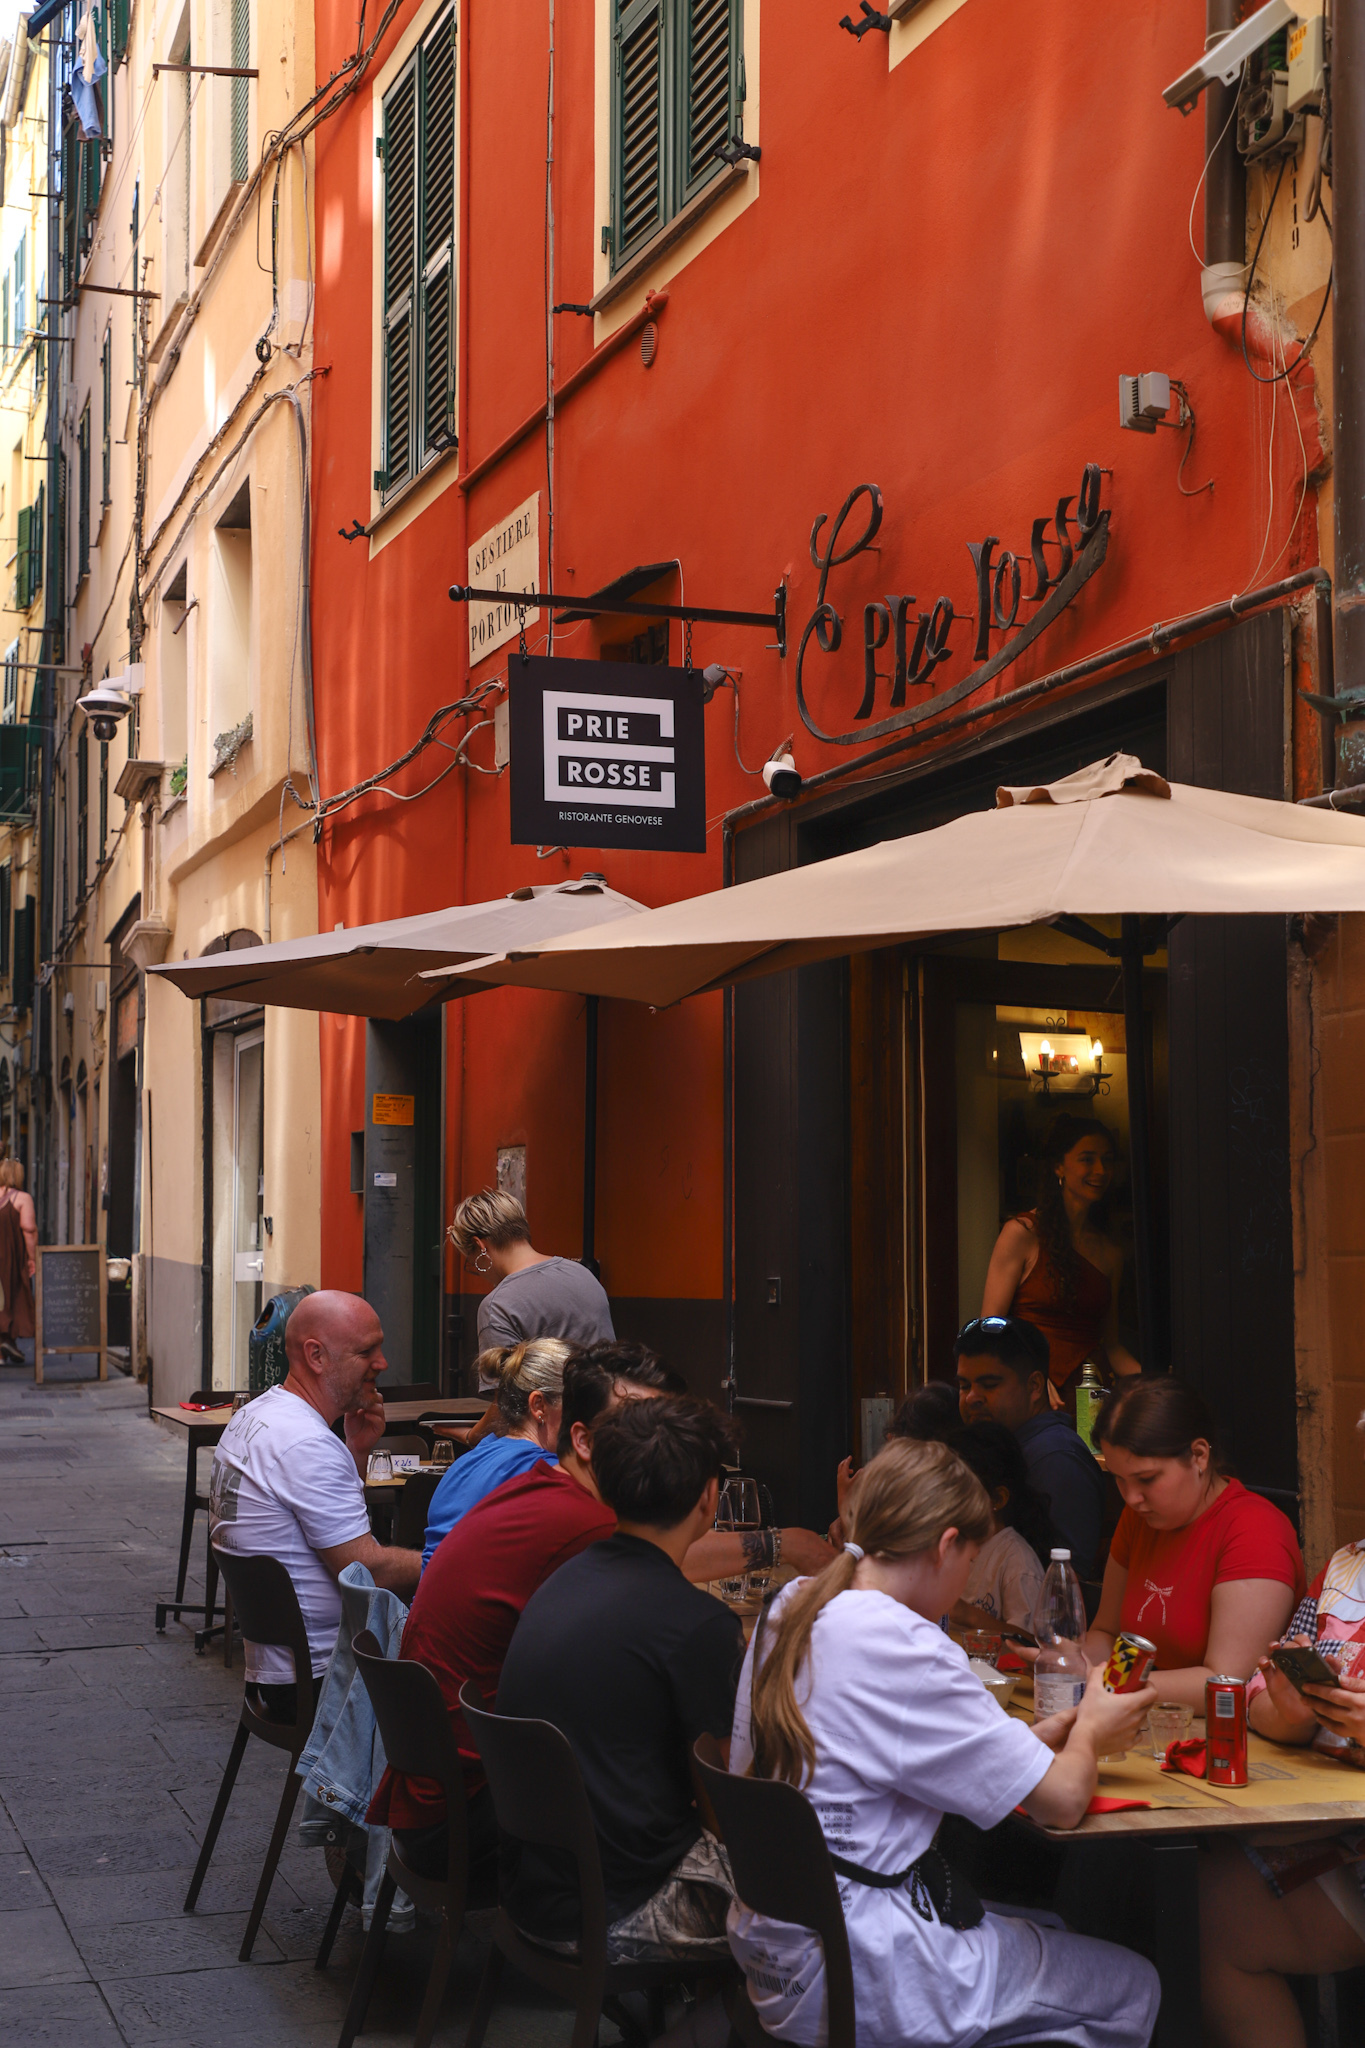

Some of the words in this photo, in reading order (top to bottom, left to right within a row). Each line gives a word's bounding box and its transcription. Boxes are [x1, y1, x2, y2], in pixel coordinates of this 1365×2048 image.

[475, 512, 531, 576] SESTIERE
[495, 568, 507, 591] DI
[567, 713, 629, 739] PRIE
[567, 761, 650, 787] ROSSE
[558, 811, 613, 823] RISTORANTE
[614, 814, 663, 826] GENOVESE
